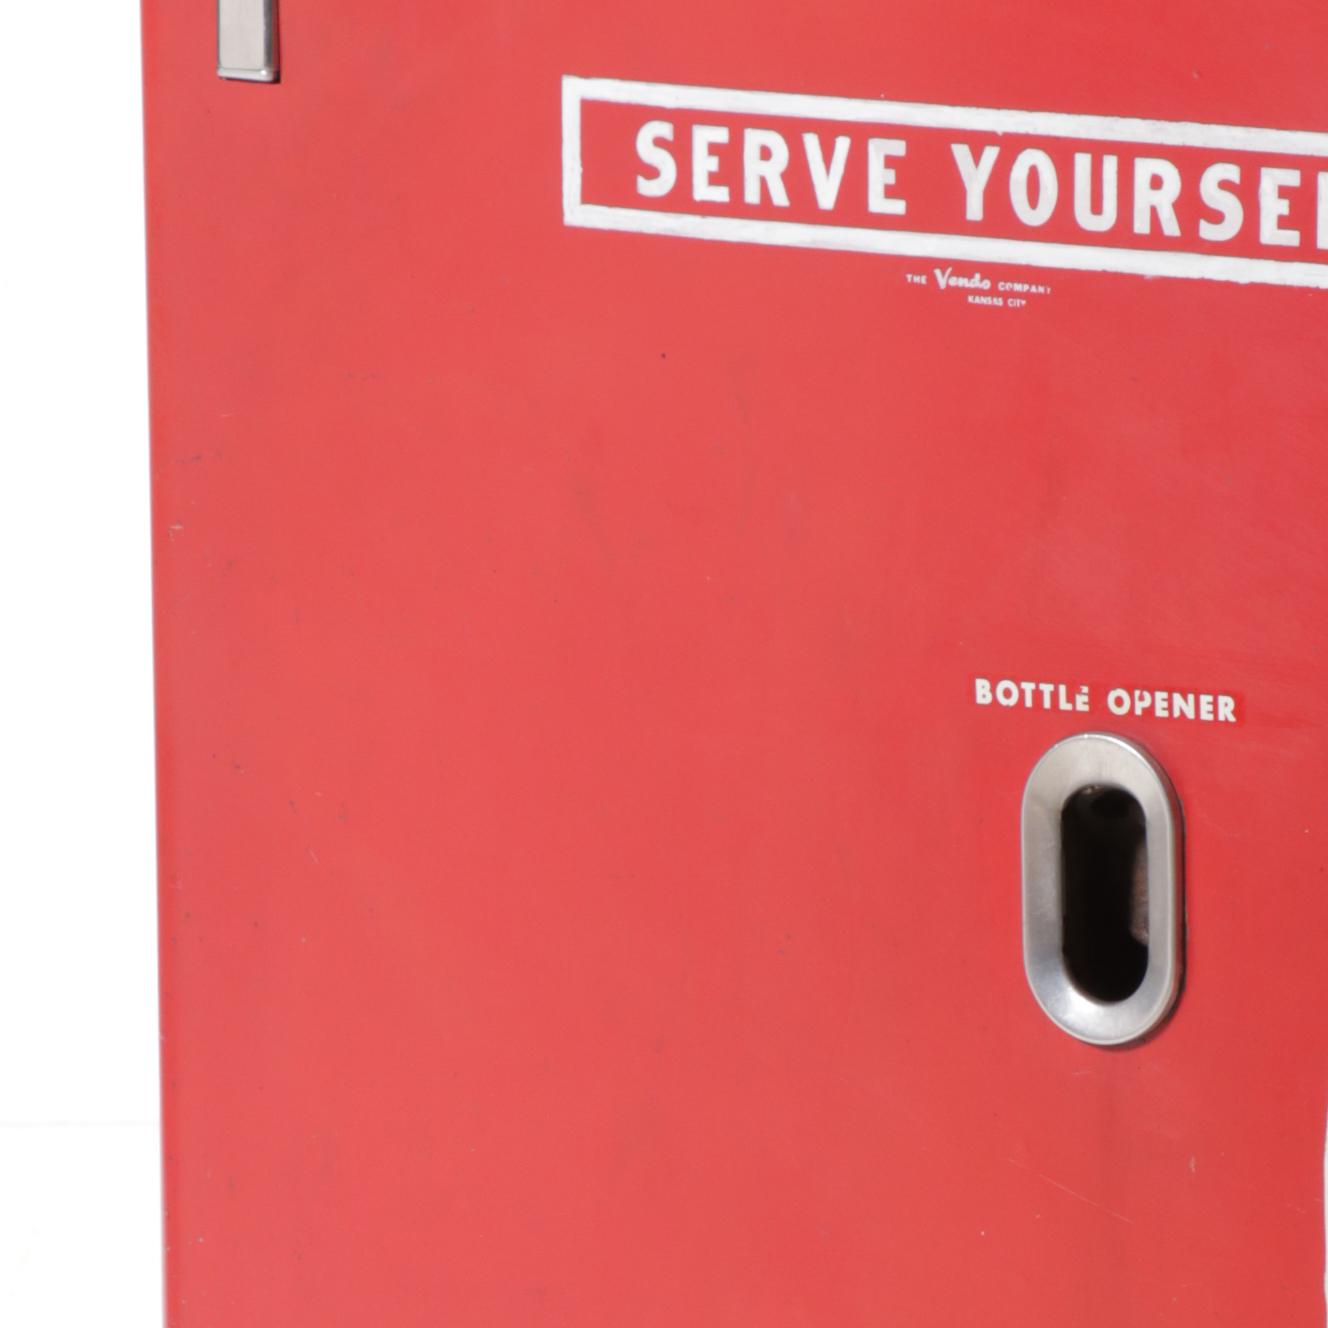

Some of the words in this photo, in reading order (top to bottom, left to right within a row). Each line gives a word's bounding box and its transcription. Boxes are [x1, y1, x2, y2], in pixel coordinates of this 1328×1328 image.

[634, 120, 906, 215] SERVE
[906, 274, 927, 285] THE
[933, 267, 991, 290] Vendo
[967, 295, 1003, 307] KANSAS
[975, 678, 1090, 712] BOTTLE
[1107, 688, 1237, 722] OPENER
